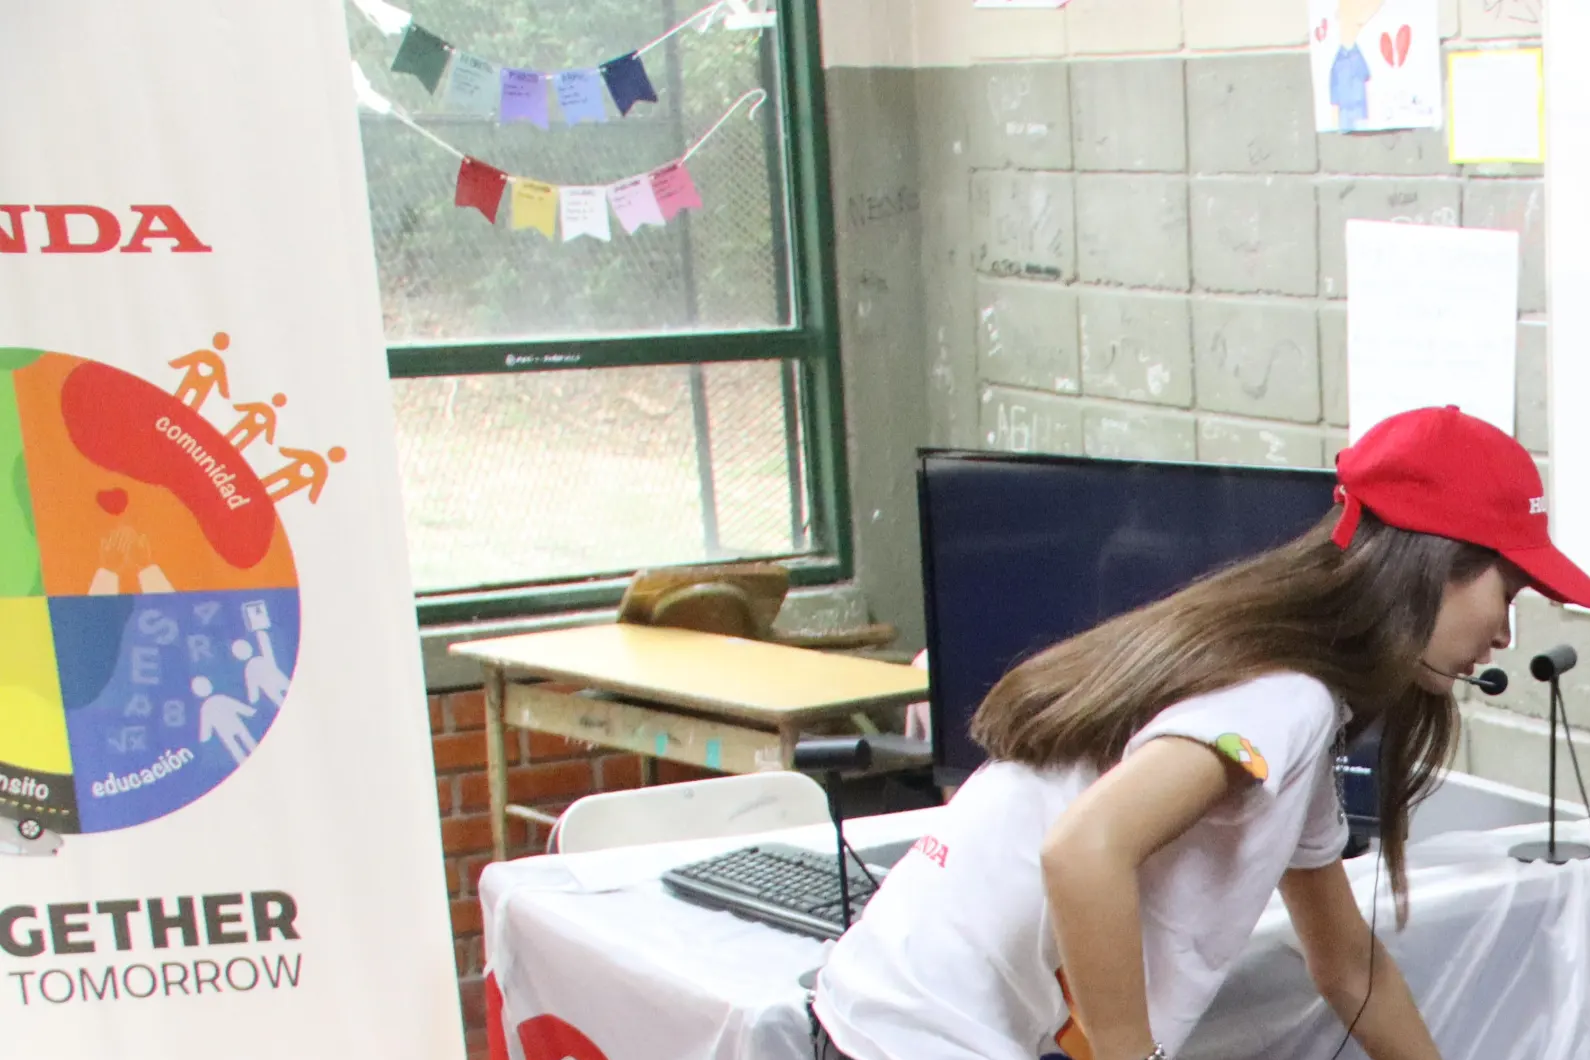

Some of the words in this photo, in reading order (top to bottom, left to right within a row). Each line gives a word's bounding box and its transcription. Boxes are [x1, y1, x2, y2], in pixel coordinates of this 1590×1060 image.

[155, 416, 252, 511] comunidad
[0, 774, 49, 801] nsito
[92, 748, 194, 798] educación
[0, 890, 301, 957] GETHER
[8, 953, 302, 1005] TOMORROW
